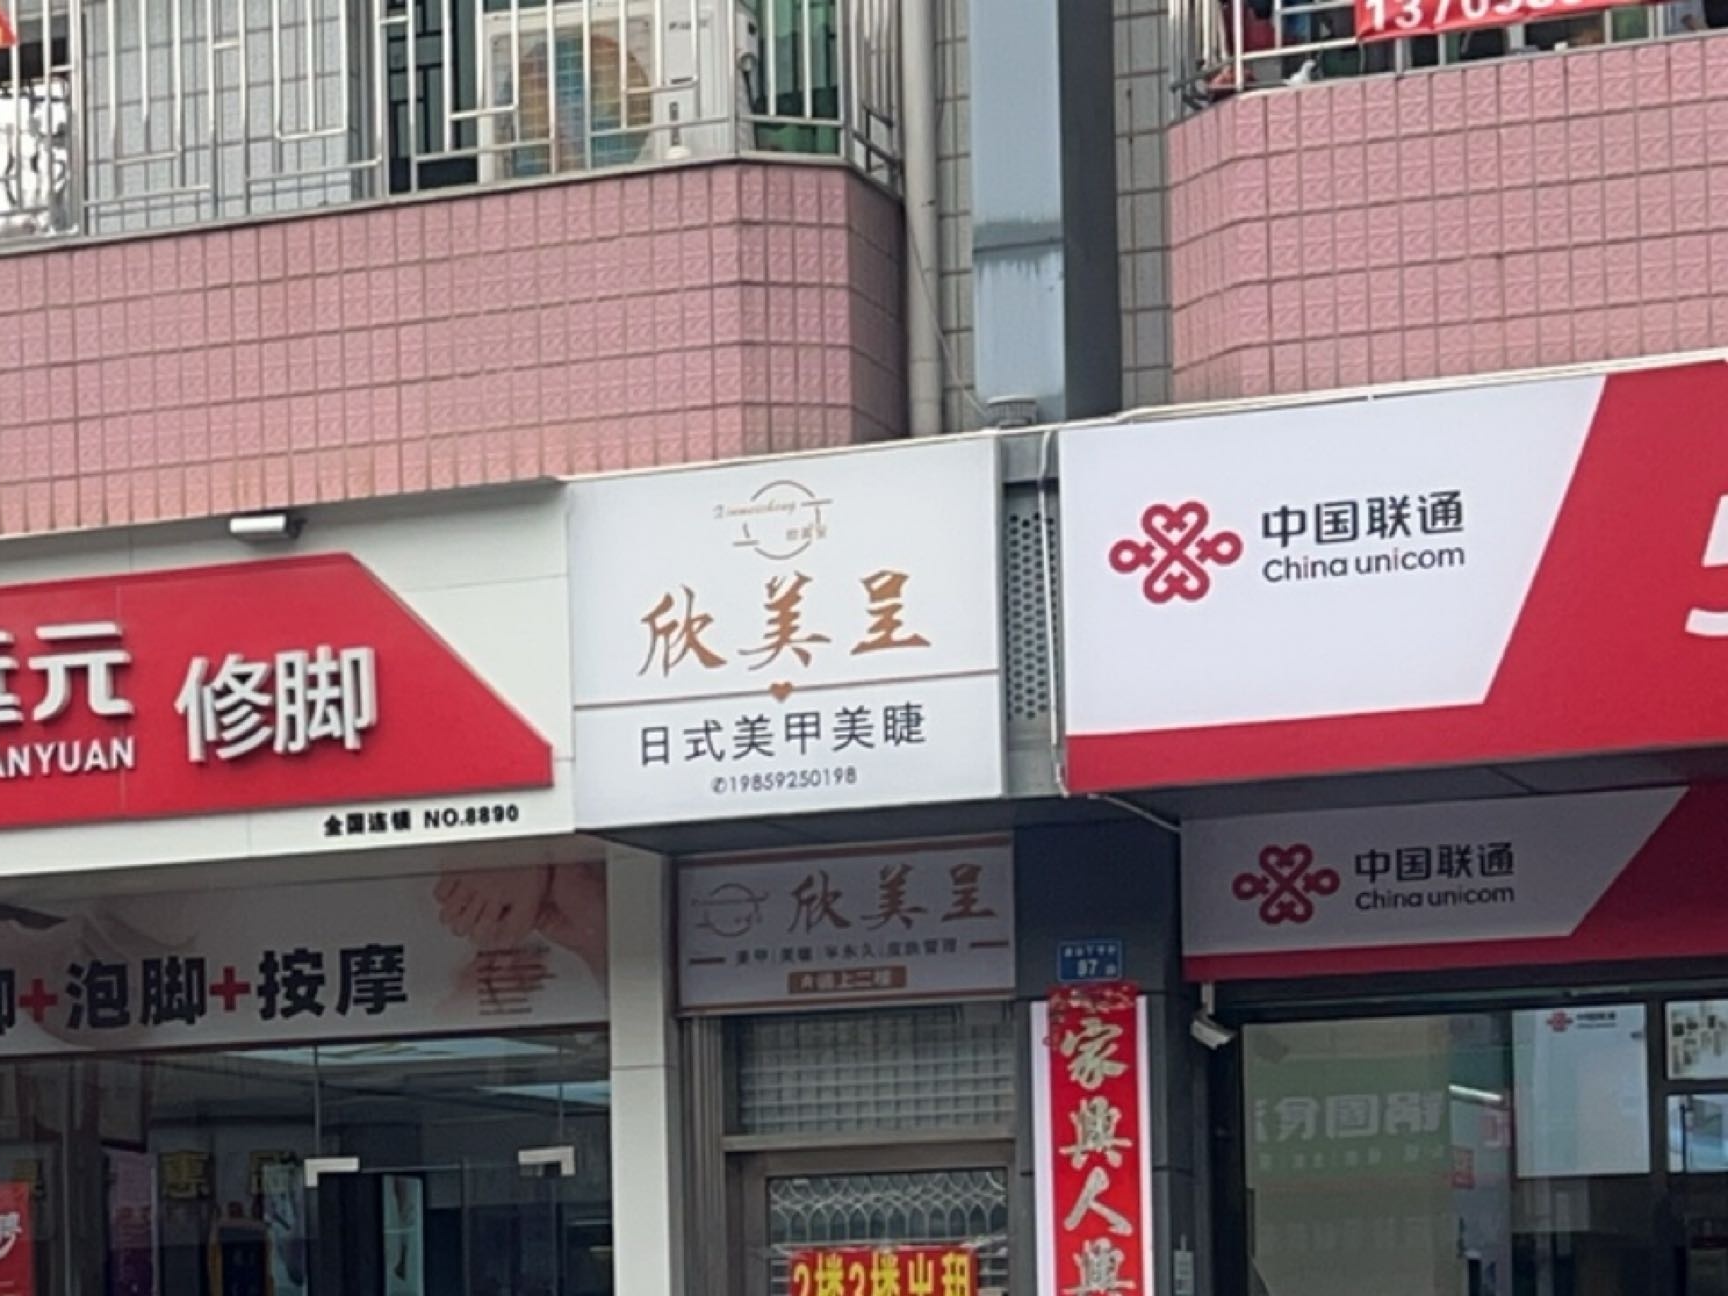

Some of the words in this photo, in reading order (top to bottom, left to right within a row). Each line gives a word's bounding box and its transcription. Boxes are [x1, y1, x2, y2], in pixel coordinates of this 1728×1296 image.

[1261, 489, 1465, 549] 中国联通
[1263, 553, 1349, 583] China
[1356, 544, 1466, 575] unicom
[637, 568, 931, 679] 欣美呈
[173, 643, 377, 765] 修脚
[640, 701, 928, 766] 日式美甲美睫
[729, 766, 858, 794] 19859250198
[1353, 842, 1515, 884] 中国联通
[1355, 887, 1423, 911] China
[1427, 883, 1515, 906] unicom
